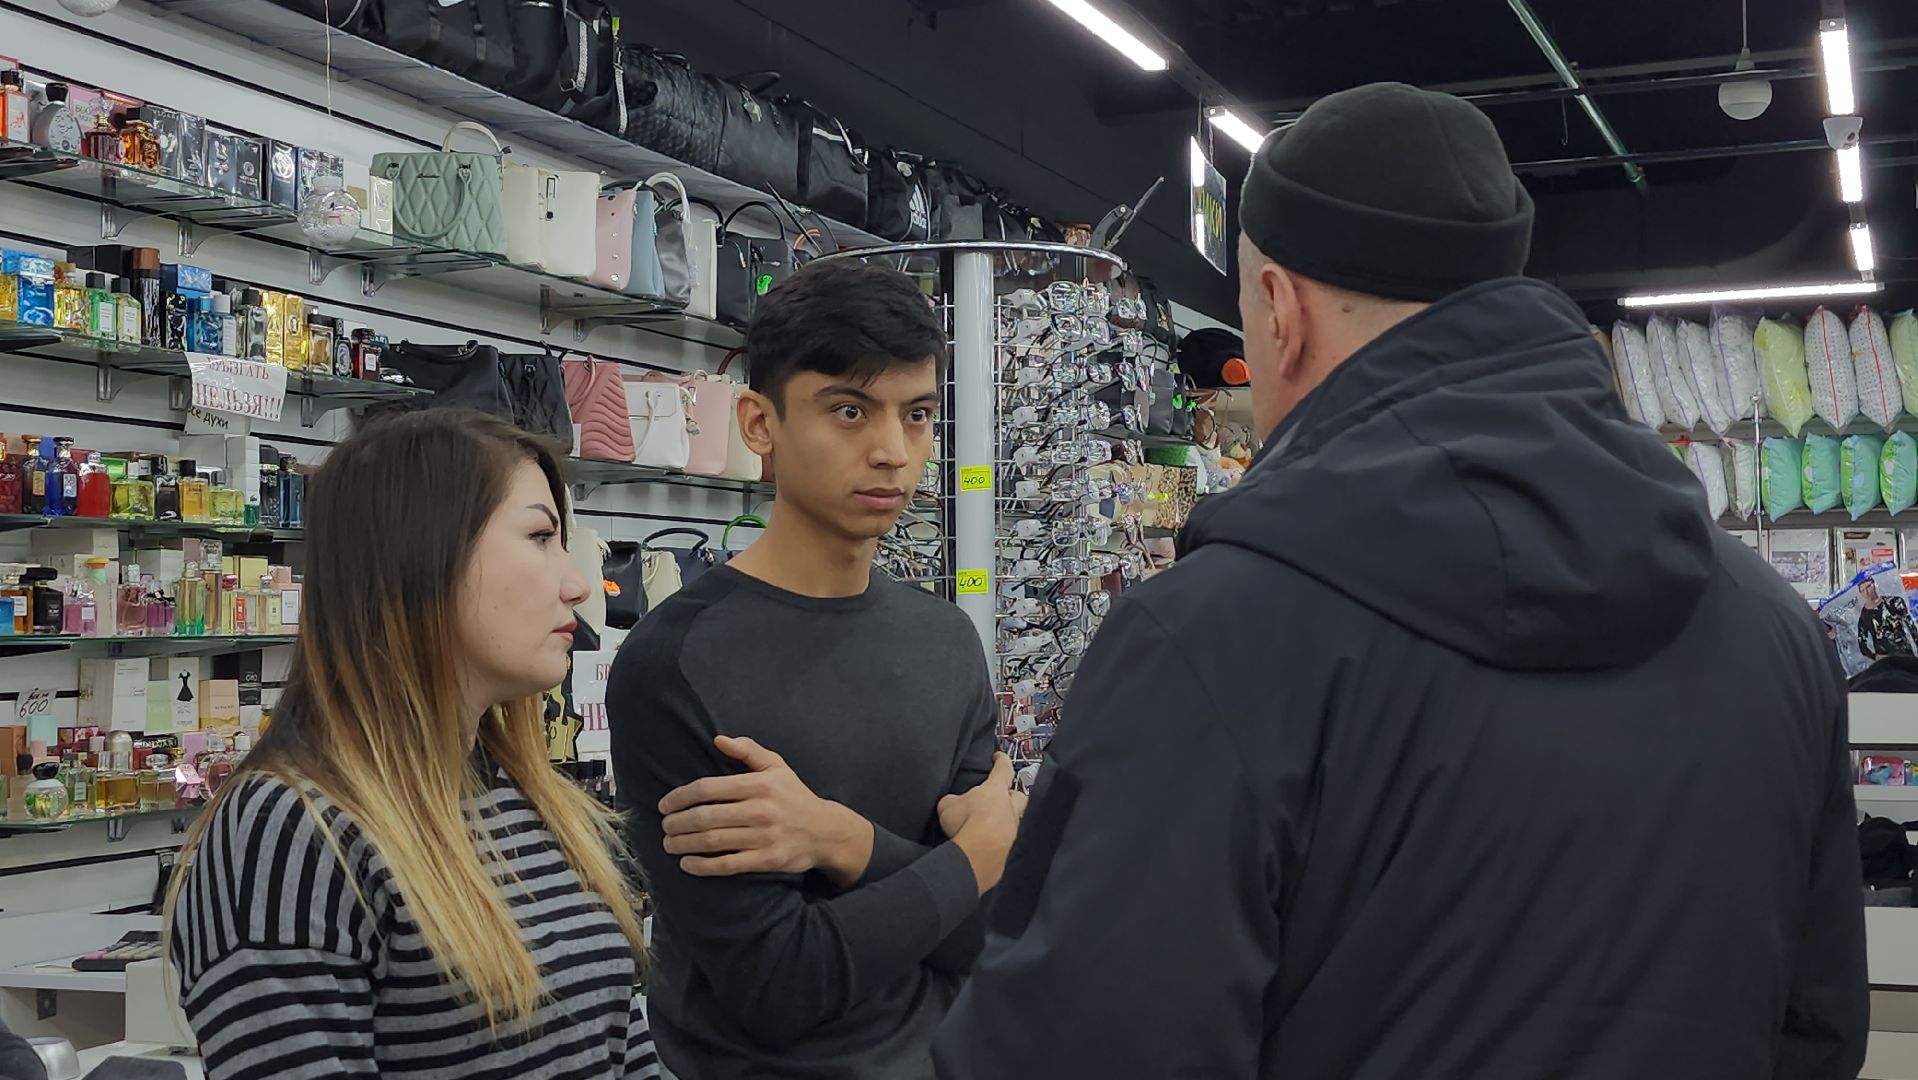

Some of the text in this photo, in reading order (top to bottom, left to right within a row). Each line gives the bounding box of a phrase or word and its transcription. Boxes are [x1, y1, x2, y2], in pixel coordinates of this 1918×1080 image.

[188, 405, 229, 429] се духи
[963, 476, 985, 485] 400
[959, 576, 983, 588] 400
[20, 699, 49, 718] 600
